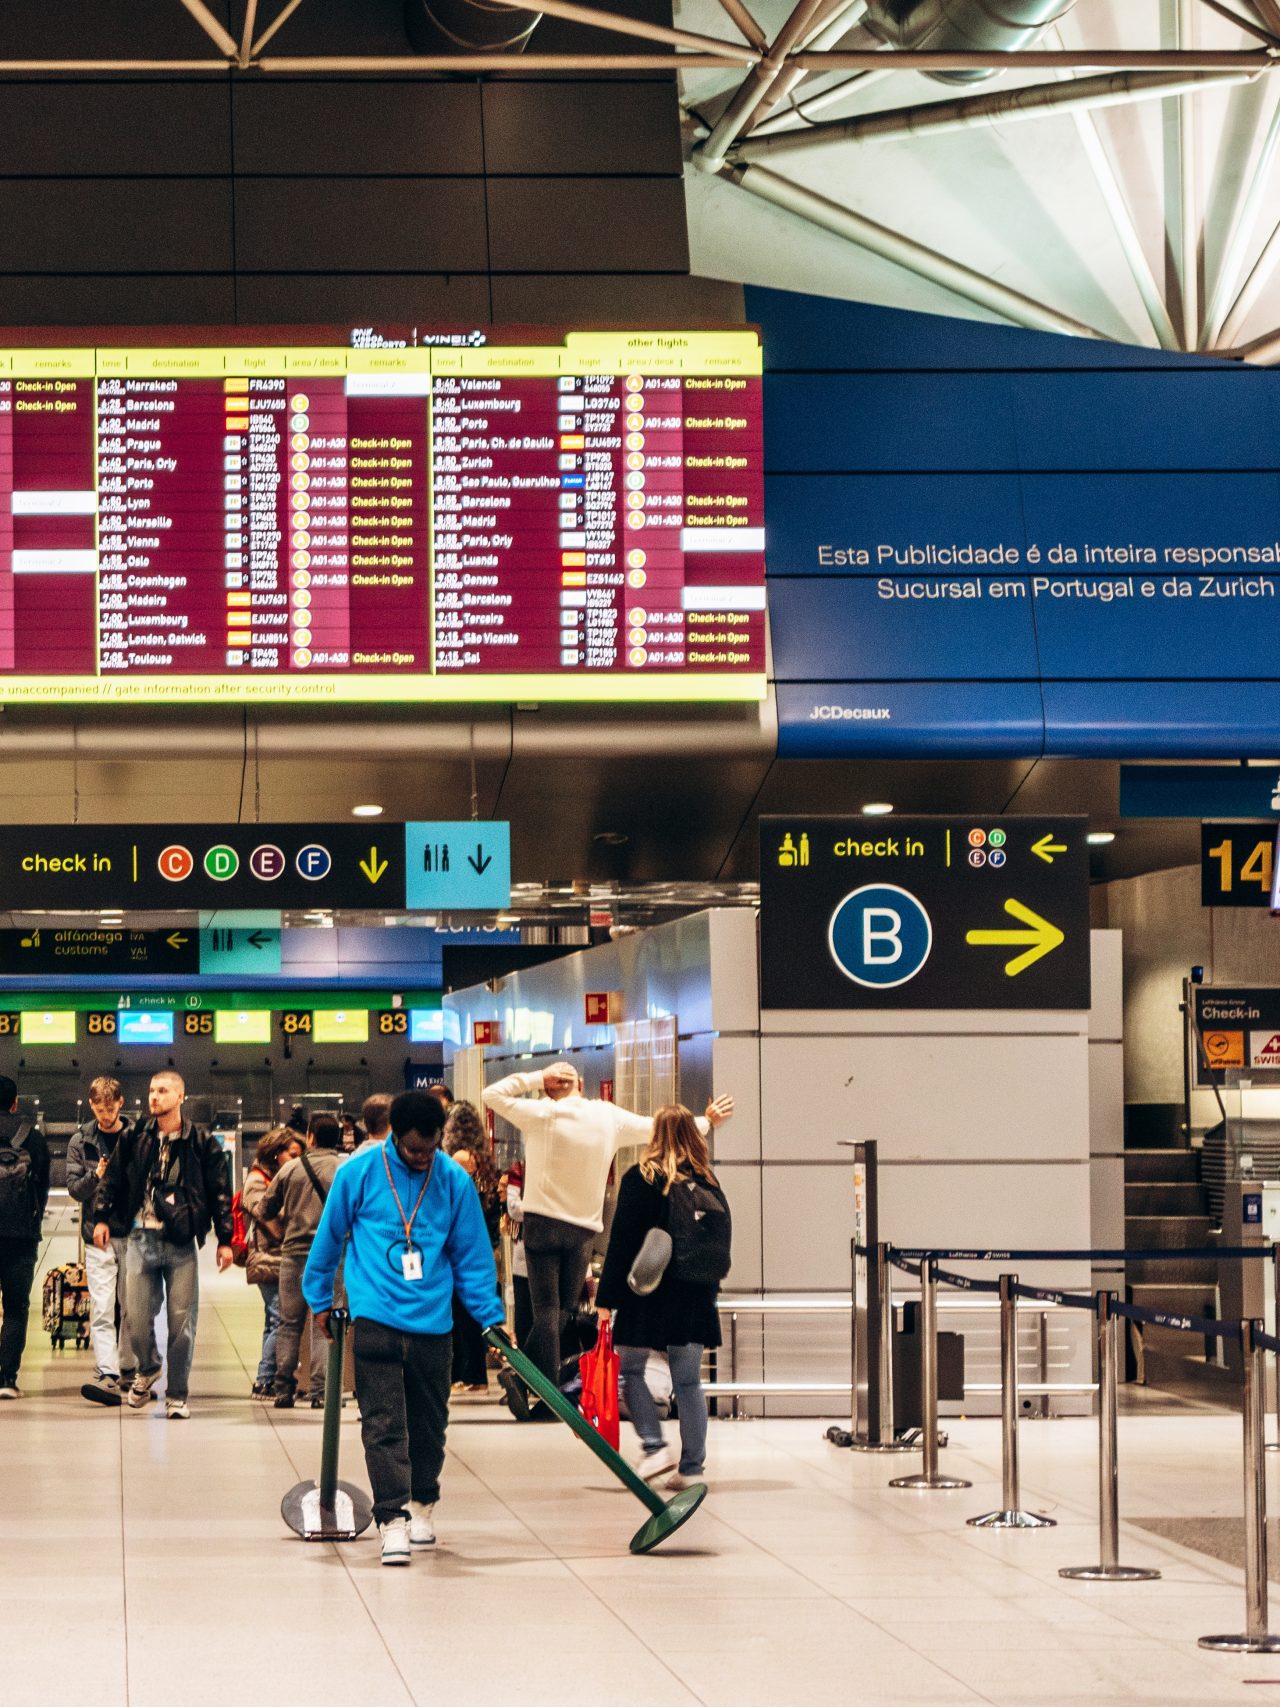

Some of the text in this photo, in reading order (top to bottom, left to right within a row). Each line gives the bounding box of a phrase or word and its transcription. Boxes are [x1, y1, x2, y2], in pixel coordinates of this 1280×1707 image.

[628, 338, 688, 348] other flights
[16, 381, 54, 391] Check-in
[54, 381, 76, 393] Open
[460, 378, 746, 392] Valencia Check-in Open
[126, 438, 412, 452] Prague Check-in Open
[818, 545, 869, 565] Esta
[878, 544, 1019, 564] Publicidade
[1027, 544, 1040, 564] é
[1048, 544, 1077, 564] da
[1085, 544, 1156, 563] inteira
[127, 575, 186, 588] Copenhagen
[875, 576, 1274, 602] Sucursal em Portugal e da Zurich
[127, 614, 188, 628] Luxembourg
[8, 685, 99, 696] unaccompanied
[115, 685, 139, 696] gate
[144, 684, 210, 694] information
[215, 684, 240, 694] after
[245, 684, 291, 696] security
[295, 684, 335, 693] control
[807, 704, 890, 720] JCDecaux
[834, 832, 1001, 856] check in C D
[22, 852, 320, 874] check in C D E F
[974, 853, 1001, 864] E F
[1209, 839, 1272, 892] 14
[863, 907, 903, 965] B
[55, 945, 108, 955] customs
[1202, 1007, 1260, 1019] Check-in
[88, 1015, 115, 1033] 86
[184, 1014, 213, 1033] 85
[283, 1014, 311, 1032] 84
[379, 1013, 408, 1032] 83
